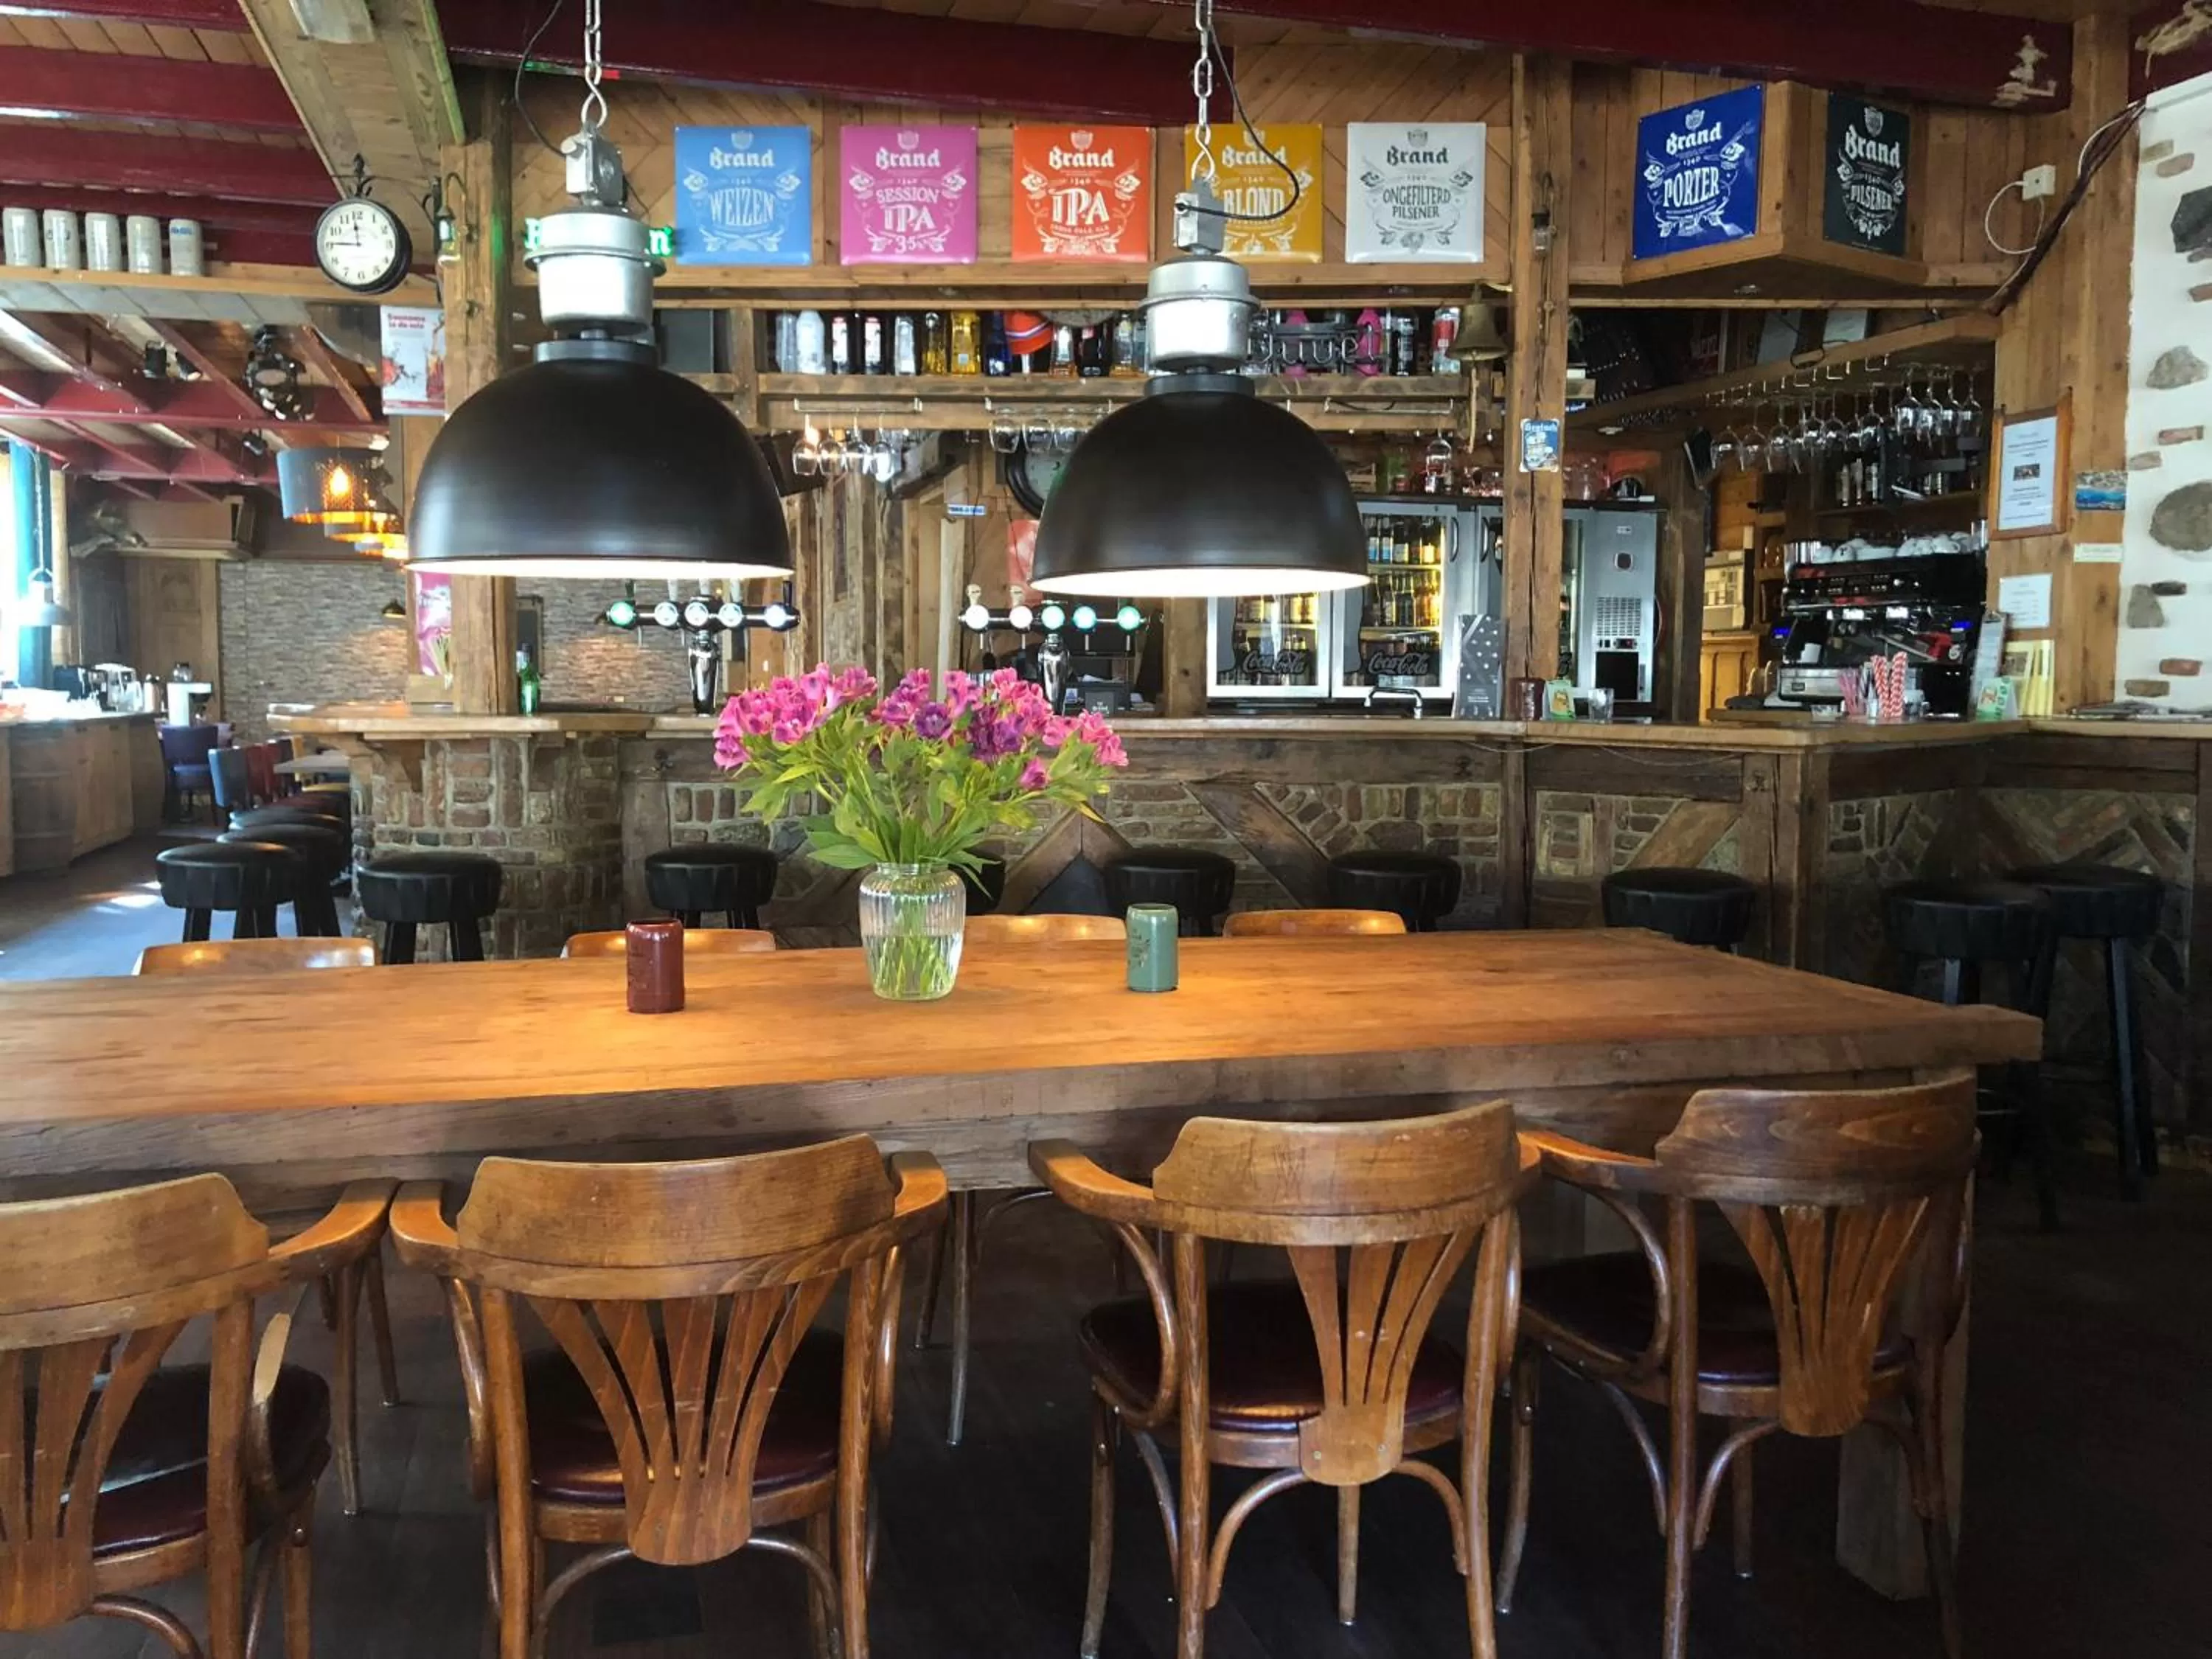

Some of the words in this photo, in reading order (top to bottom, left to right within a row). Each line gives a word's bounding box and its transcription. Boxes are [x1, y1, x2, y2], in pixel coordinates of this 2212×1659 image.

[1666, 122, 1722, 156] Brand
[1845, 124, 1900, 169] Brand
[710, 147, 776, 170] Brand
[875, 146, 941, 170] Brand
[1048, 145, 1115, 170] Brand
[1222, 145, 1287, 168] Brand
[1387, 145, 1449, 167] Brand
[876, 186, 940, 204] SESSION
[1382, 184, 1452, 205] ONGEFILTERD
[1663, 167, 1720, 207] PORTER
[1850, 185, 1893, 211] PILSENER
[710, 187, 776, 226] WEIZEN
[1048, 187, 1110, 226] IPA
[1224, 187, 1284, 218] BLOND
[1392, 206, 1440, 219] PILSENER
[880, 204, 936, 232] IPA
